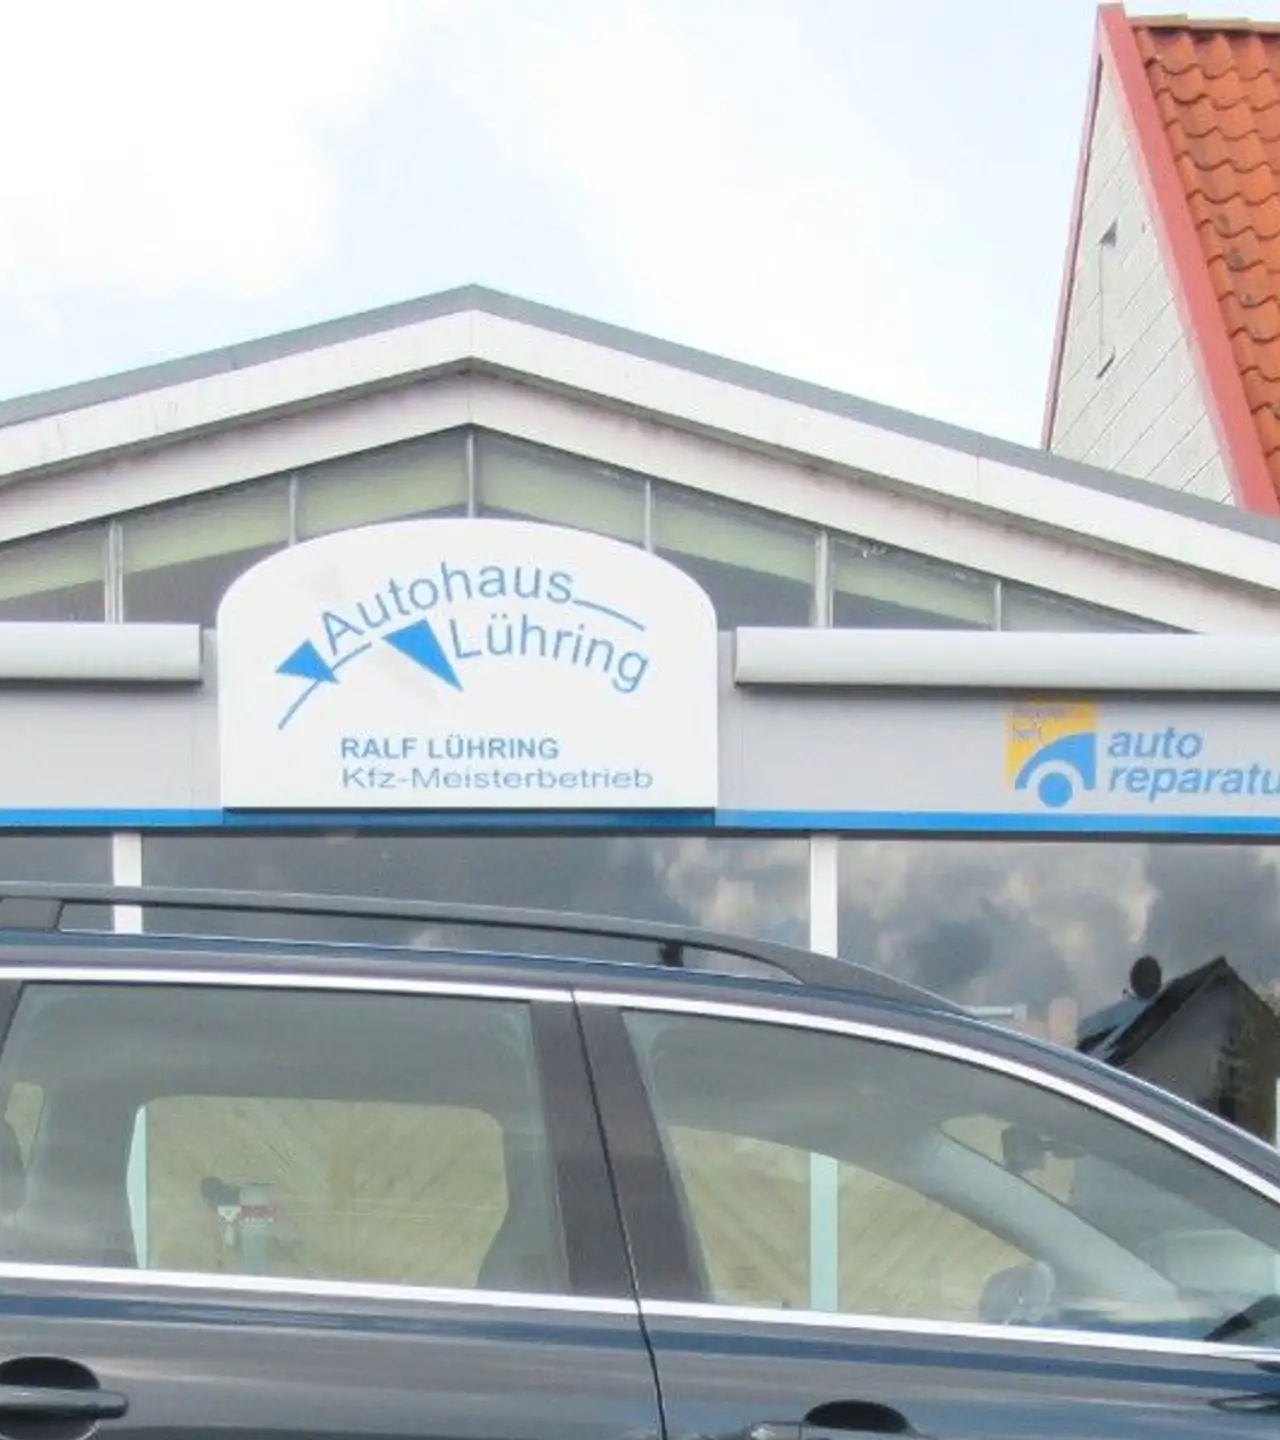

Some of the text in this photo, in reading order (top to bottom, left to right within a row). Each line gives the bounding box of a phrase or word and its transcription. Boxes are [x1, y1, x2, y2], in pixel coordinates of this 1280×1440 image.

[321, 561, 574, 656] Autohaus
[449, 612, 650, 693] Lühring
[340, 735, 560, 759] RALF LÜHRING
[1107, 727, 1203, 759] auto
[342, 766, 654, 790] Kfz-Meisterbetrieb
